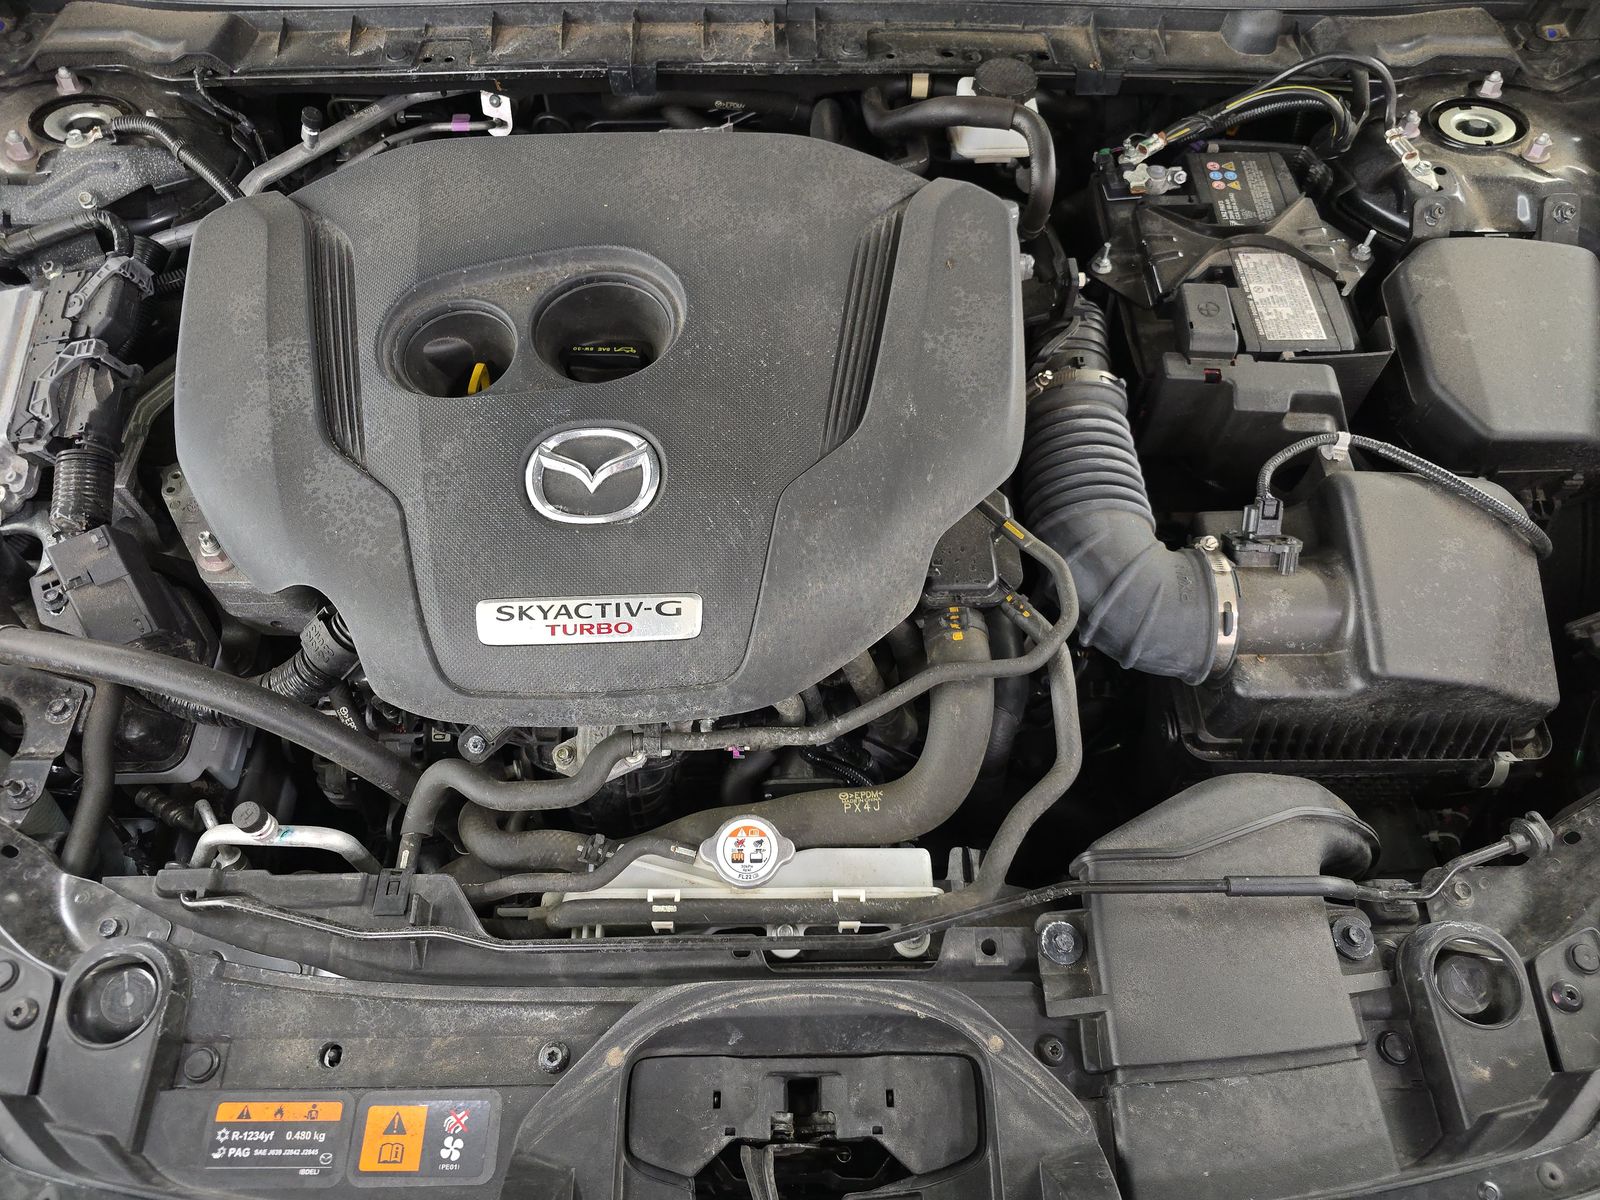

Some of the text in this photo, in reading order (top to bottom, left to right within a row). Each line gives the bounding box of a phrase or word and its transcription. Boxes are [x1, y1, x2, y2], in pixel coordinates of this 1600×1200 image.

[495, 600, 682, 622] SKYACTIV-G
[545, 621, 633, 637] TURBO
[231, 1131, 326, 1142] R-1234yf 0.480 kg
[227, 1147, 251, 1158] PAG
[253, 1148, 267, 1156] SAE
